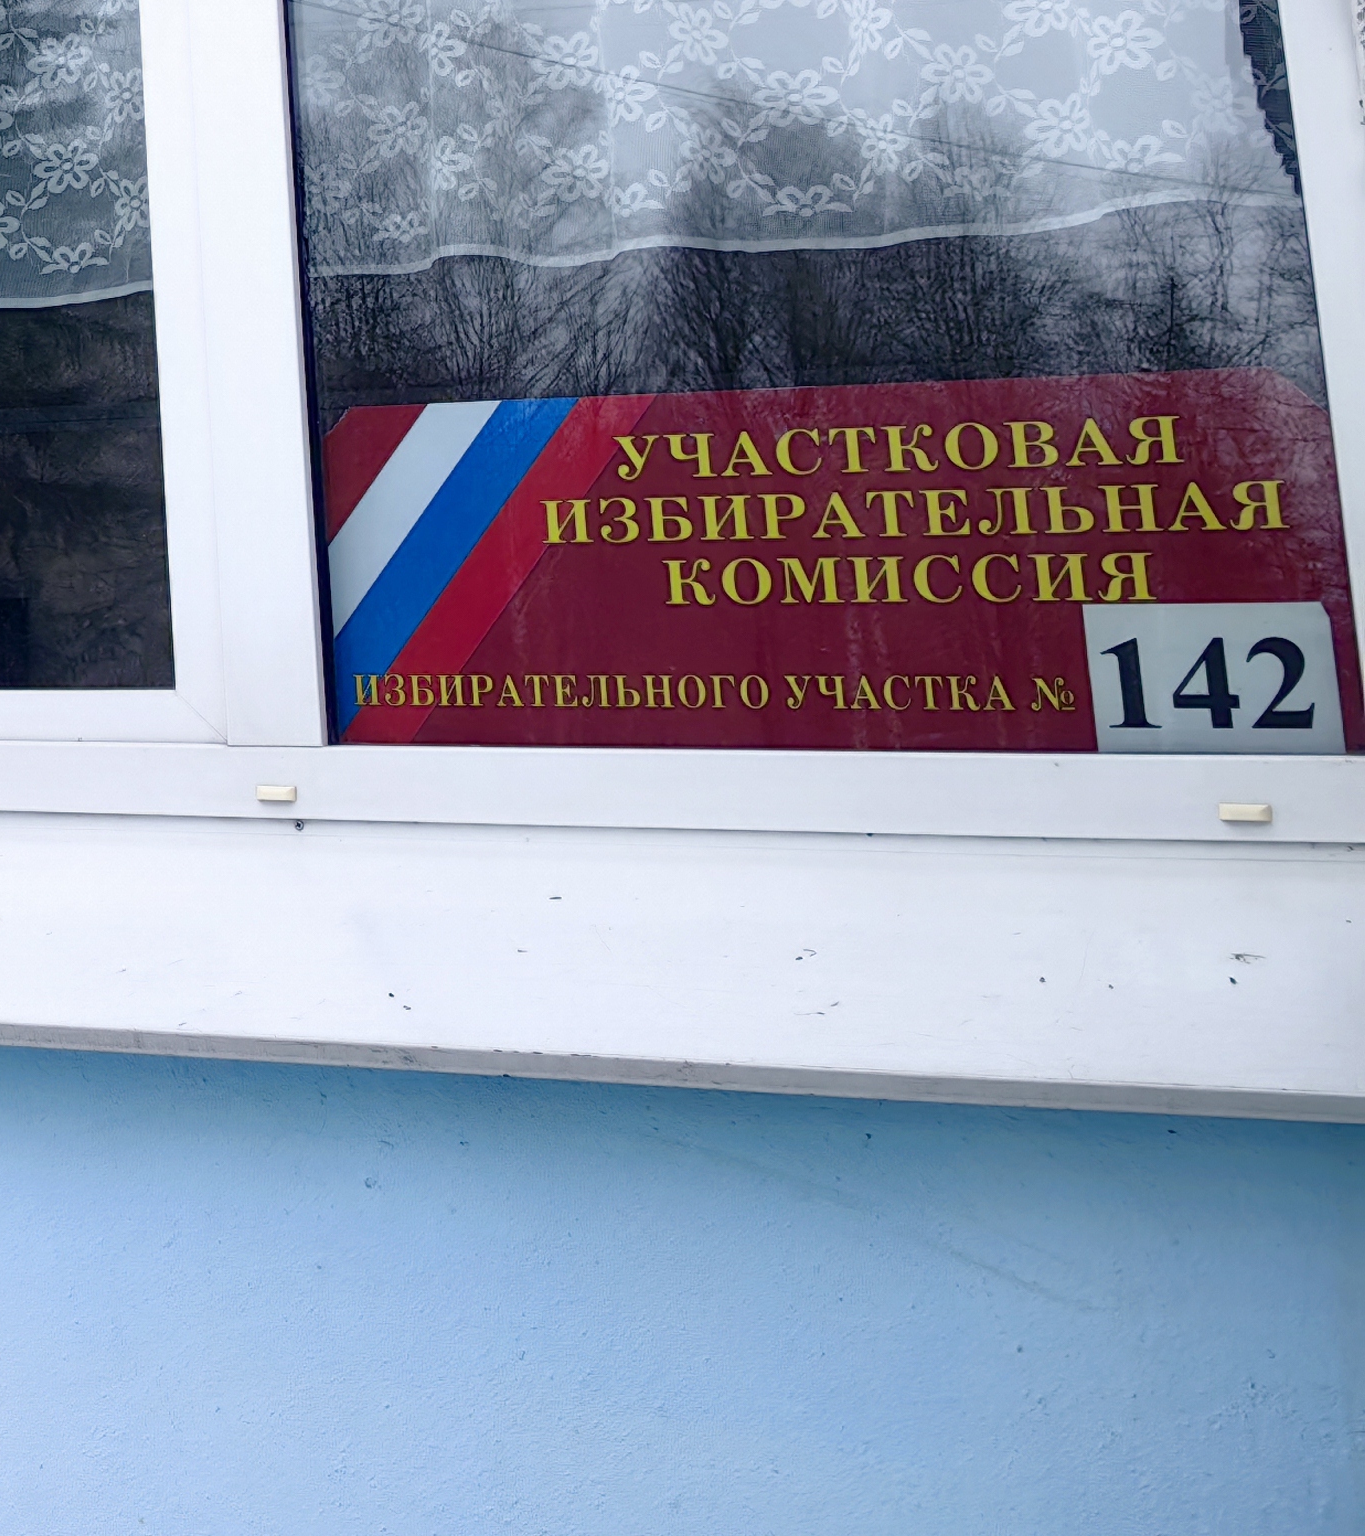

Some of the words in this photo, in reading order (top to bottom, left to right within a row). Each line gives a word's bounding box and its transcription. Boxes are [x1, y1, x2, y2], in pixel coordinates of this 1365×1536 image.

[613, 414, 1184, 482] УЧАСТКОВАЯ
[541, 479, 1291, 546] ИЗБИРАТЕЛЬНАЯ
[665, 551, 1157, 606] КОМИССИЯ
[353, 672, 770, 711] ИЗБИРАТЕЛЬНОГО
[786, 675, 1015, 712] УЧАСТКА
[1030, 677, 1076, 713] №
[1100, 635, 1316, 731] 142
